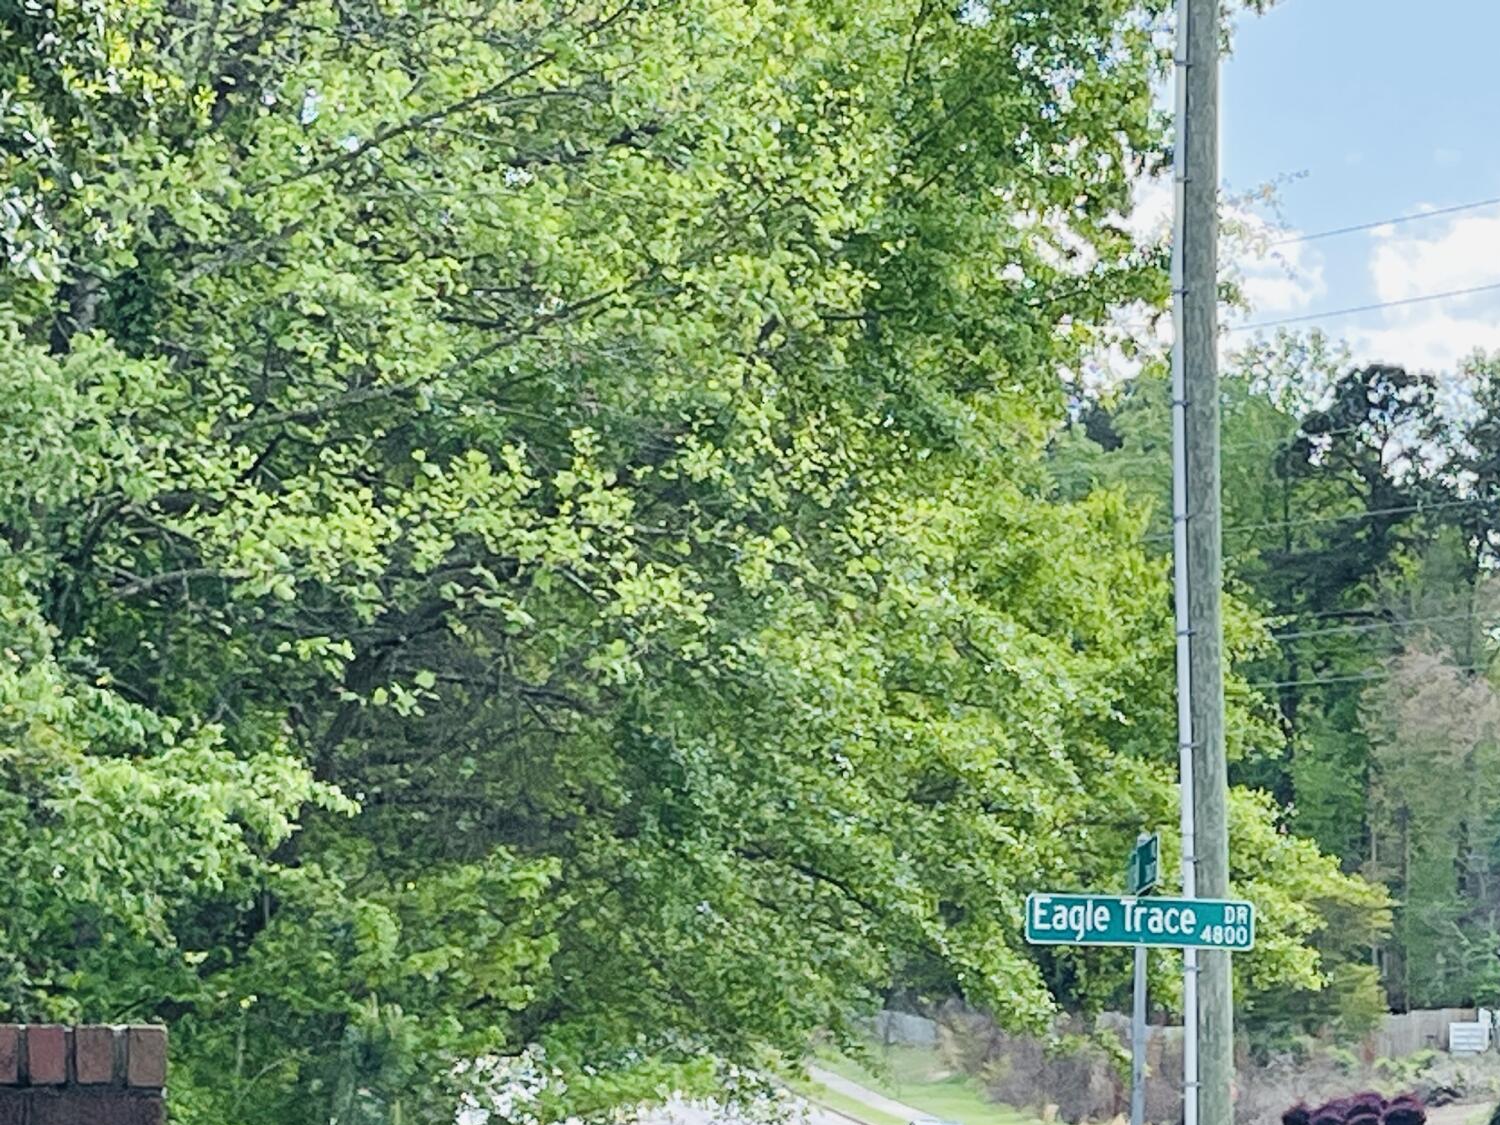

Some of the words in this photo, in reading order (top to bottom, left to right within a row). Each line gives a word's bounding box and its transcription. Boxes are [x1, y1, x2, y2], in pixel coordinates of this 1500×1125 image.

[1033, 898, 1110, 941] Eagle
[1120, 898, 1197, 934] Trace
[1224, 906, 1248, 925] DR
[1200, 926, 1248, 945] 4800
